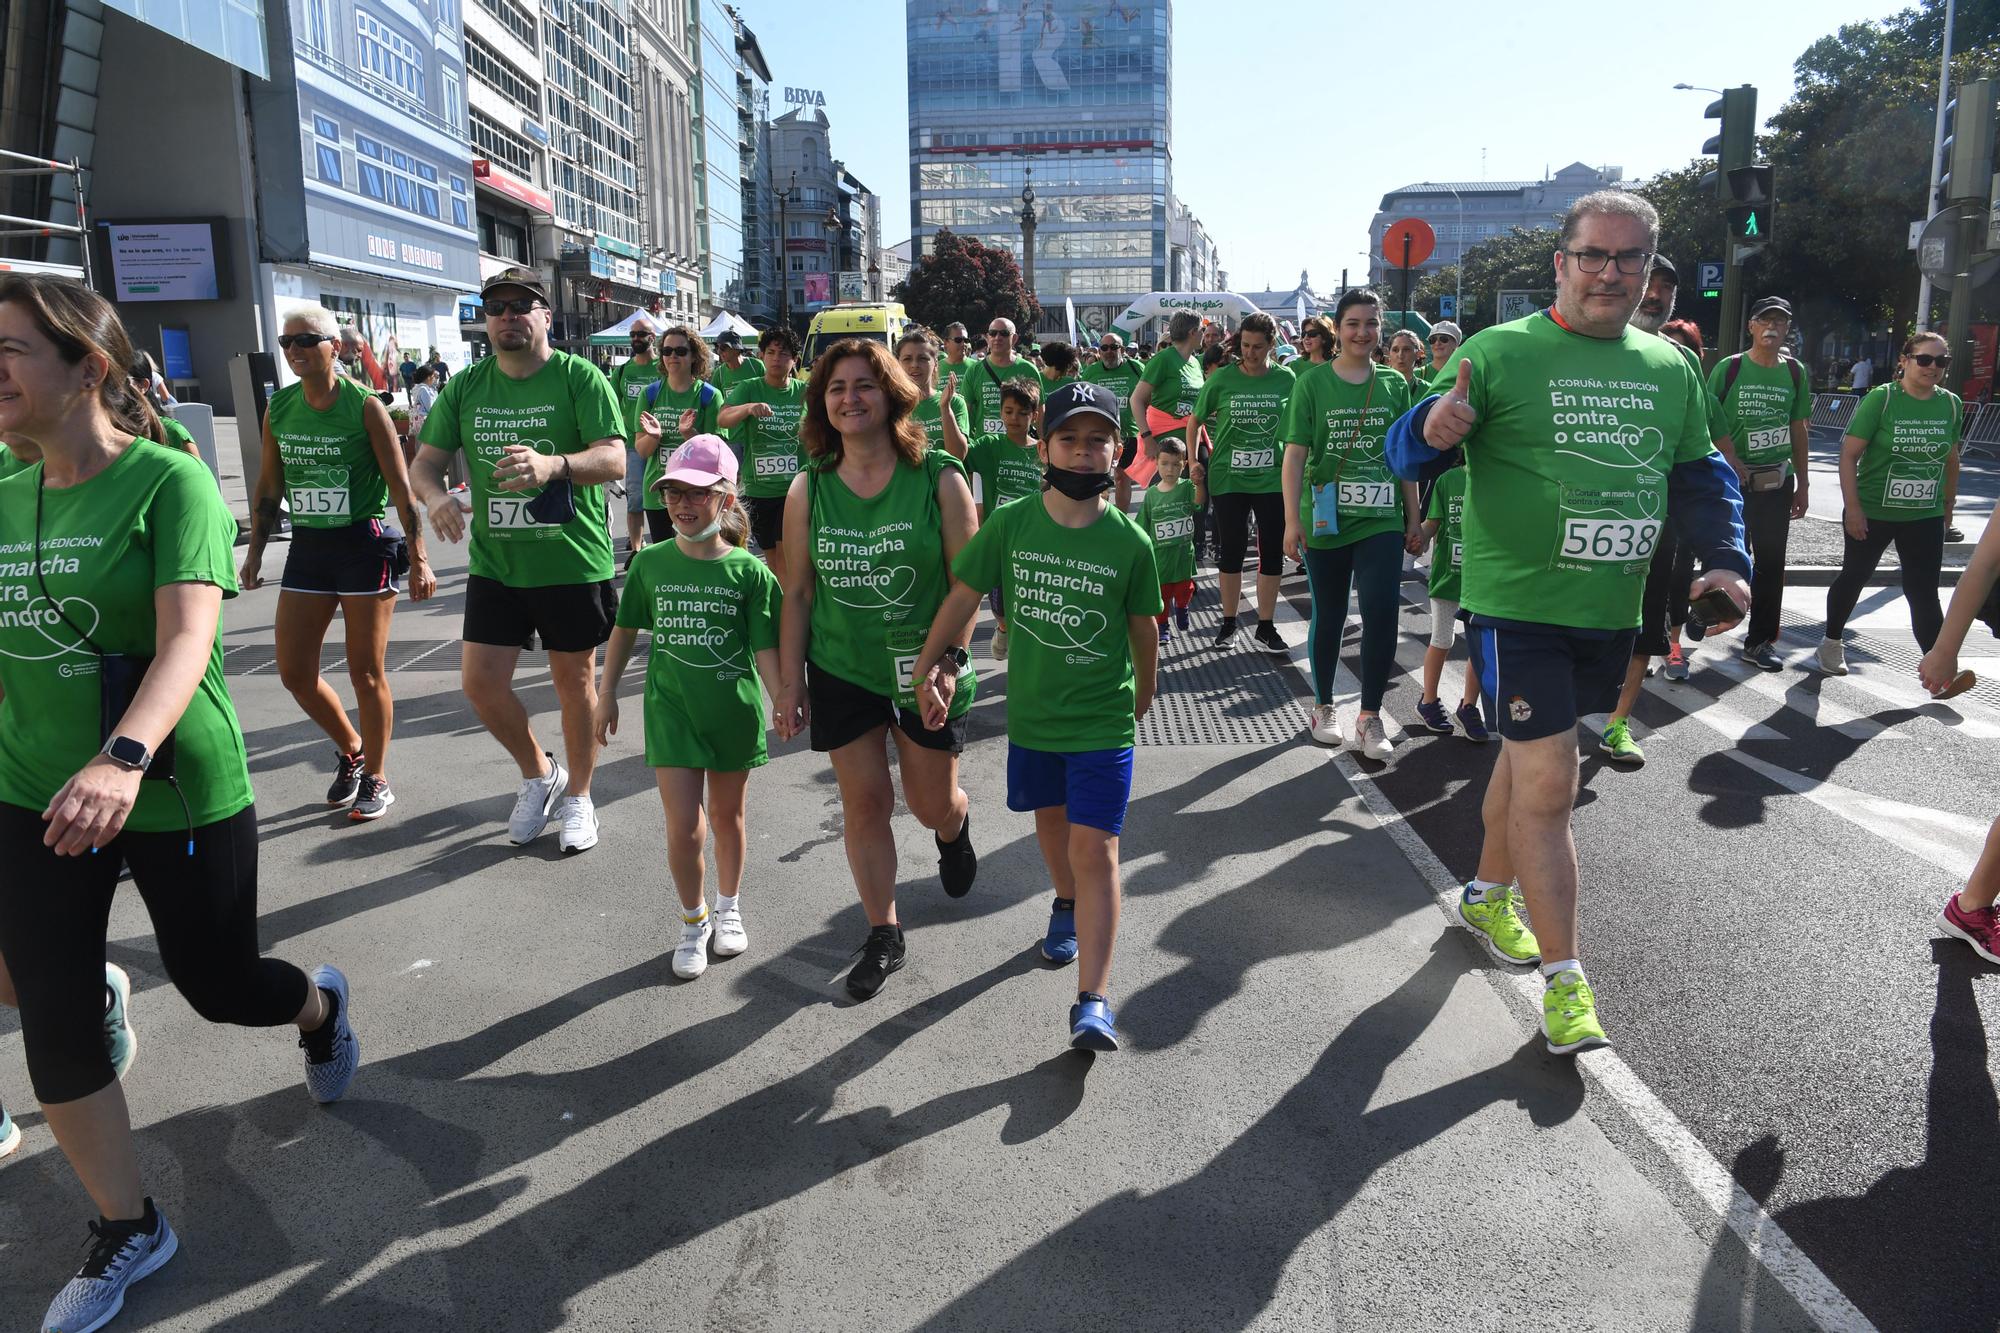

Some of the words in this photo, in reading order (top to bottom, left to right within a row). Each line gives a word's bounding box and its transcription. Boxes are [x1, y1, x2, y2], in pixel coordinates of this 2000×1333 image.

[784, 87, 827, 106] BBVA
[1702, 265, 1719, 288] P
[1506, 296, 1525, 304] YES
[1703, 290, 1719, 298] LIBRE
[1160, 298, 1168, 307] El
[1169, 298, 1191, 308] Corte
[1191, 296, 1224, 311] Inglés
[1506, 303, 1520, 311] WE
[1072, 383, 1095, 402] NY
[1548, 379, 1557, 388] A
[1608, 380, 1619, 389] IX
[1620, 381, 1659, 393] EDICIÓN
[1230, 400, 1240, 408] En
[1243, 400, 1276, 408] marcha
[1550, 391, 1577, 407] En
[1582, 393, 1655, 411] marcha
[1738, 391, 1750, 399] En
[1752, 392, 1785, 402] marcha
[1738, 399, 1767, 408] contra
[482, 407, 515, 416] CORUÑA
[526, 404, 555, 415] EDICIÓN
[1230, 408, 1258, 416] contra
[474, 416, 491, 428] En
[494, 416, 547, 428] marcha
[1327, 418, 1340, 428] En
[1343, 416, 1385, 427] macha
[1553, 410, 1619, 426] contra
[984, 421, 1004, 432] 592
[1894, 426, 1906, 435] En
[1909, 426, 1945, 435] marcha
[473, 430, 519, 442] contra
[1554, 431, 1568, 444] o
[1750, 428, 1788, 449] 5367
[1893, 436, 1927, 444] contra
[294, 445, 341, 455] marcha
[757, 457, 797, 474] 5596
[1232, 451, 1273, 467] 5372
[998, 467, 1009, 475] En
[1340, 484, 1394, 505] 5371
[1601, 490, 1611, 498] en
[1612, 489, 1635, 498] marcha
[1891, 483, 1934, 498] 6034
[293, 491, 347, 513] 5157
[490, 501, 536, 525] 570
[824, 526, 864, 538] CORUÑA
[869, 529, 876, 538] IX
[877, 521, 912, 536] EDICIÓN
[1157, 518, 1194, 539] 5370
[0, 541, 32, 553] RUÑA
[51, 534, 103, 549] EDICIÓN
[817, 538, 835, 553] En
[840, 537, 905, 556] marcha
[1564, 523, 1657, 557] 5638
[817, 556, 871, 572] contra
[1012, 550, 1017, 559] A
[1018, 551, 1061, 566] CORUÑA
[1066, 559, 1076, 568] IX
[1077, 561, 1118, 578] EDICIÓN
[1012, 562, 1029, 581] En
[1034, 570, 1104, 596] marcha
[660, 584, 700, 593] CORUÑA
[704, 586, 713, 594] IX
[1014, 583, 1063, 606] contra
[656, 597, 672, 611] En
[677, 600, 737, 616] marcha
[656, 615, 706, 629] contra
[656, 634, 665, 644] o
